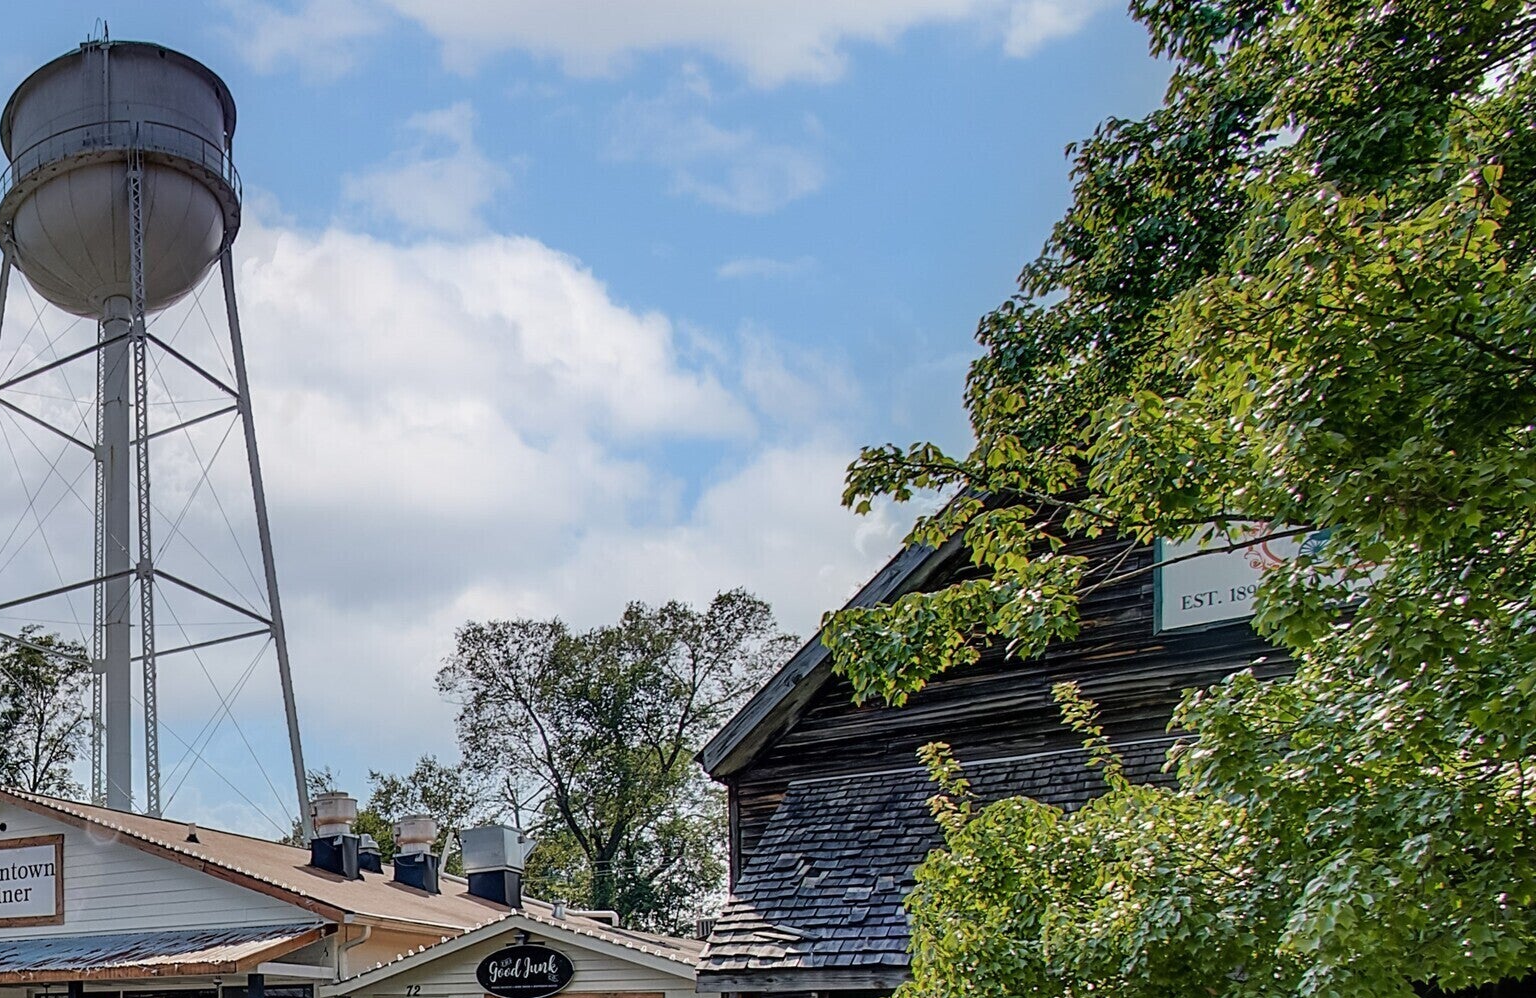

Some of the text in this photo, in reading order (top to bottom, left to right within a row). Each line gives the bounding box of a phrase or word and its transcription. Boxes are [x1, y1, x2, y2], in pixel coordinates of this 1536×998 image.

[1181, 590, 1222, 610] EST.
[489, 954, 559, 983] Good Junk
[406, 984, 421, 997] 72
